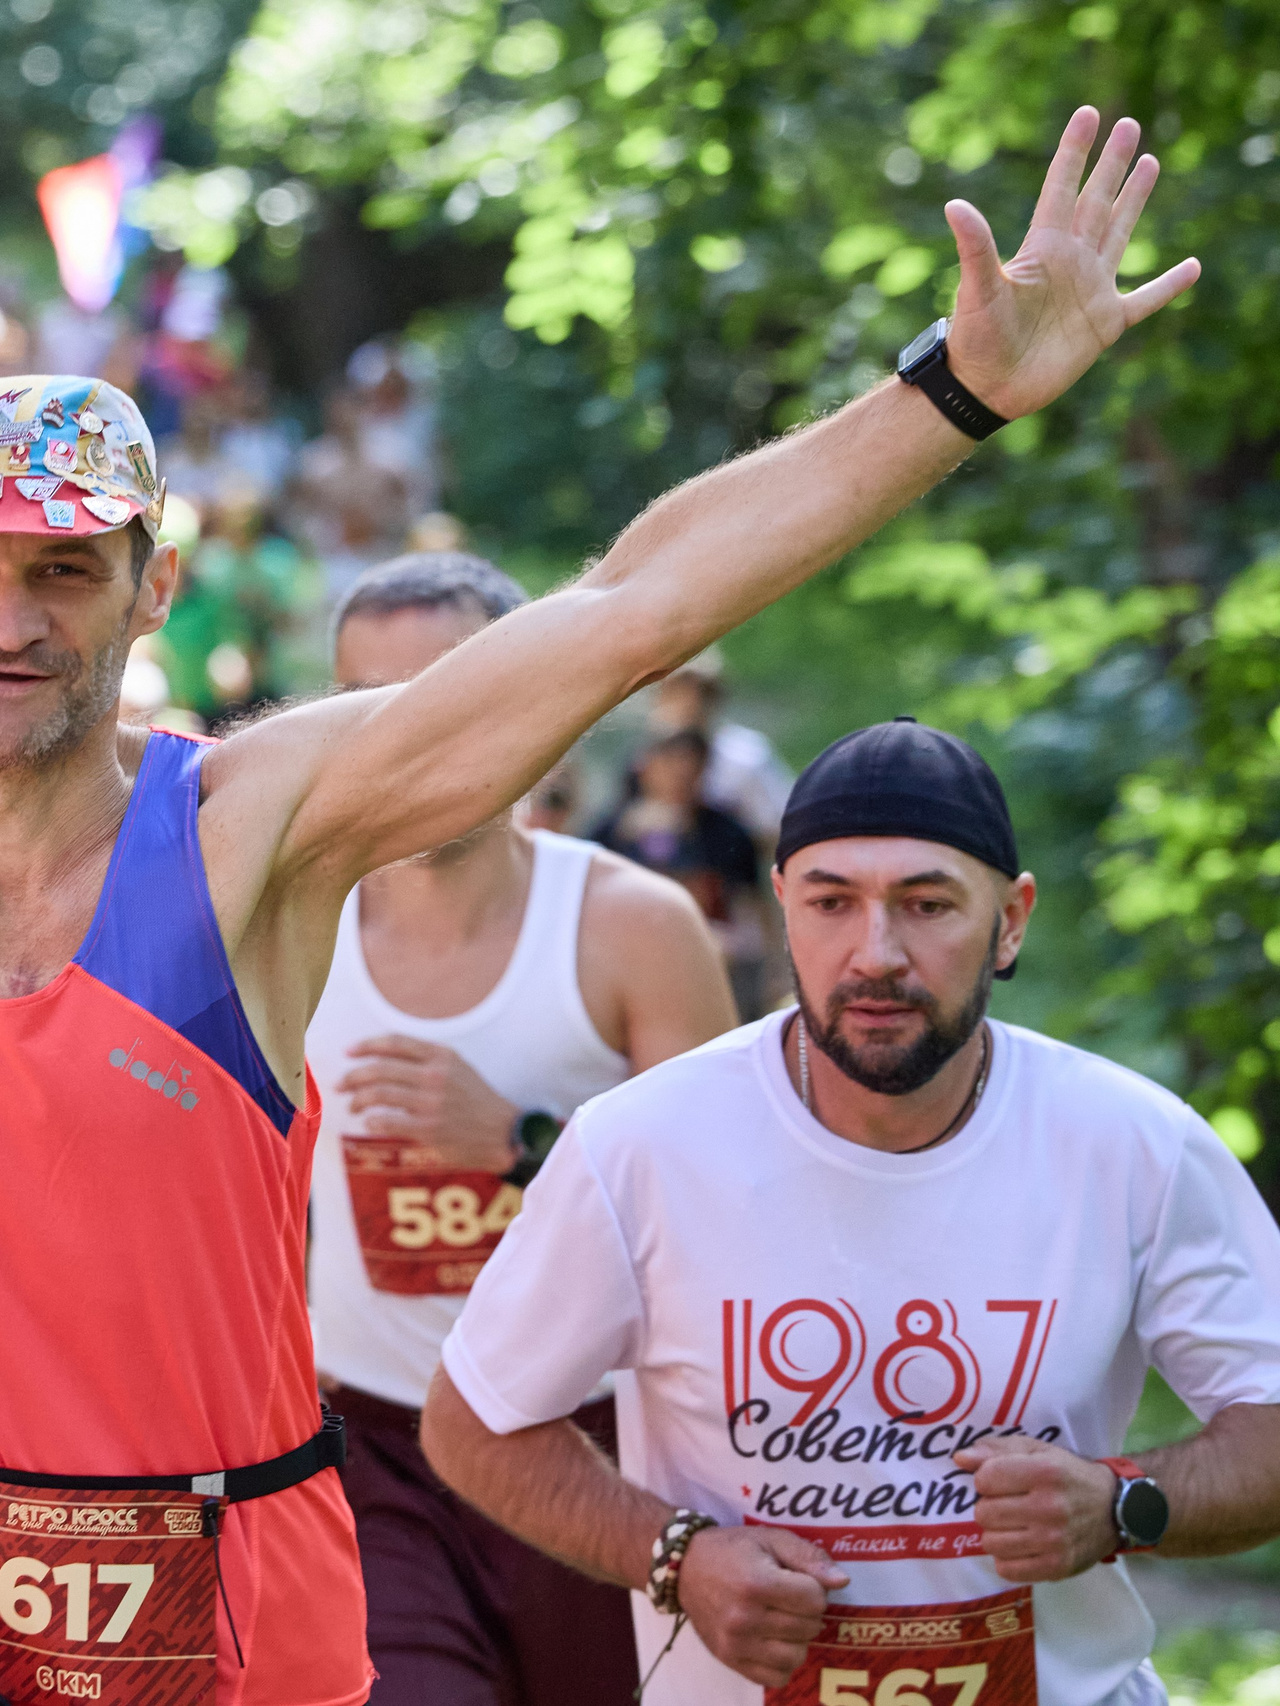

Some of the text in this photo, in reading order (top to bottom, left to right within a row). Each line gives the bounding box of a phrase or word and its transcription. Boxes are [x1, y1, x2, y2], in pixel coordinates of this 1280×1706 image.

[108, 1036, 201, 1112] diadora
[388, 1185, 523, 1248] 584
[722, 1298, 1057, 1426] 1987
[728, 1398, 1061, 1463] Советск
[754, 1469, 980, 1518] качест
[8, 1502, 138, 1525] РЕТРО КРОСС
[46, 1522, 138, 1537] физкультурника
[164, 1509, 201, 1522] СПОРТ
[831, 1534, 908, 1553] таких
[917, 1535, 946, 1550] не
[838, 1620, 962, 1638] РЕТРО КРОСС
[36, 1665, 55, 1691] 6
[821, 1662, 988, 1706] 567
